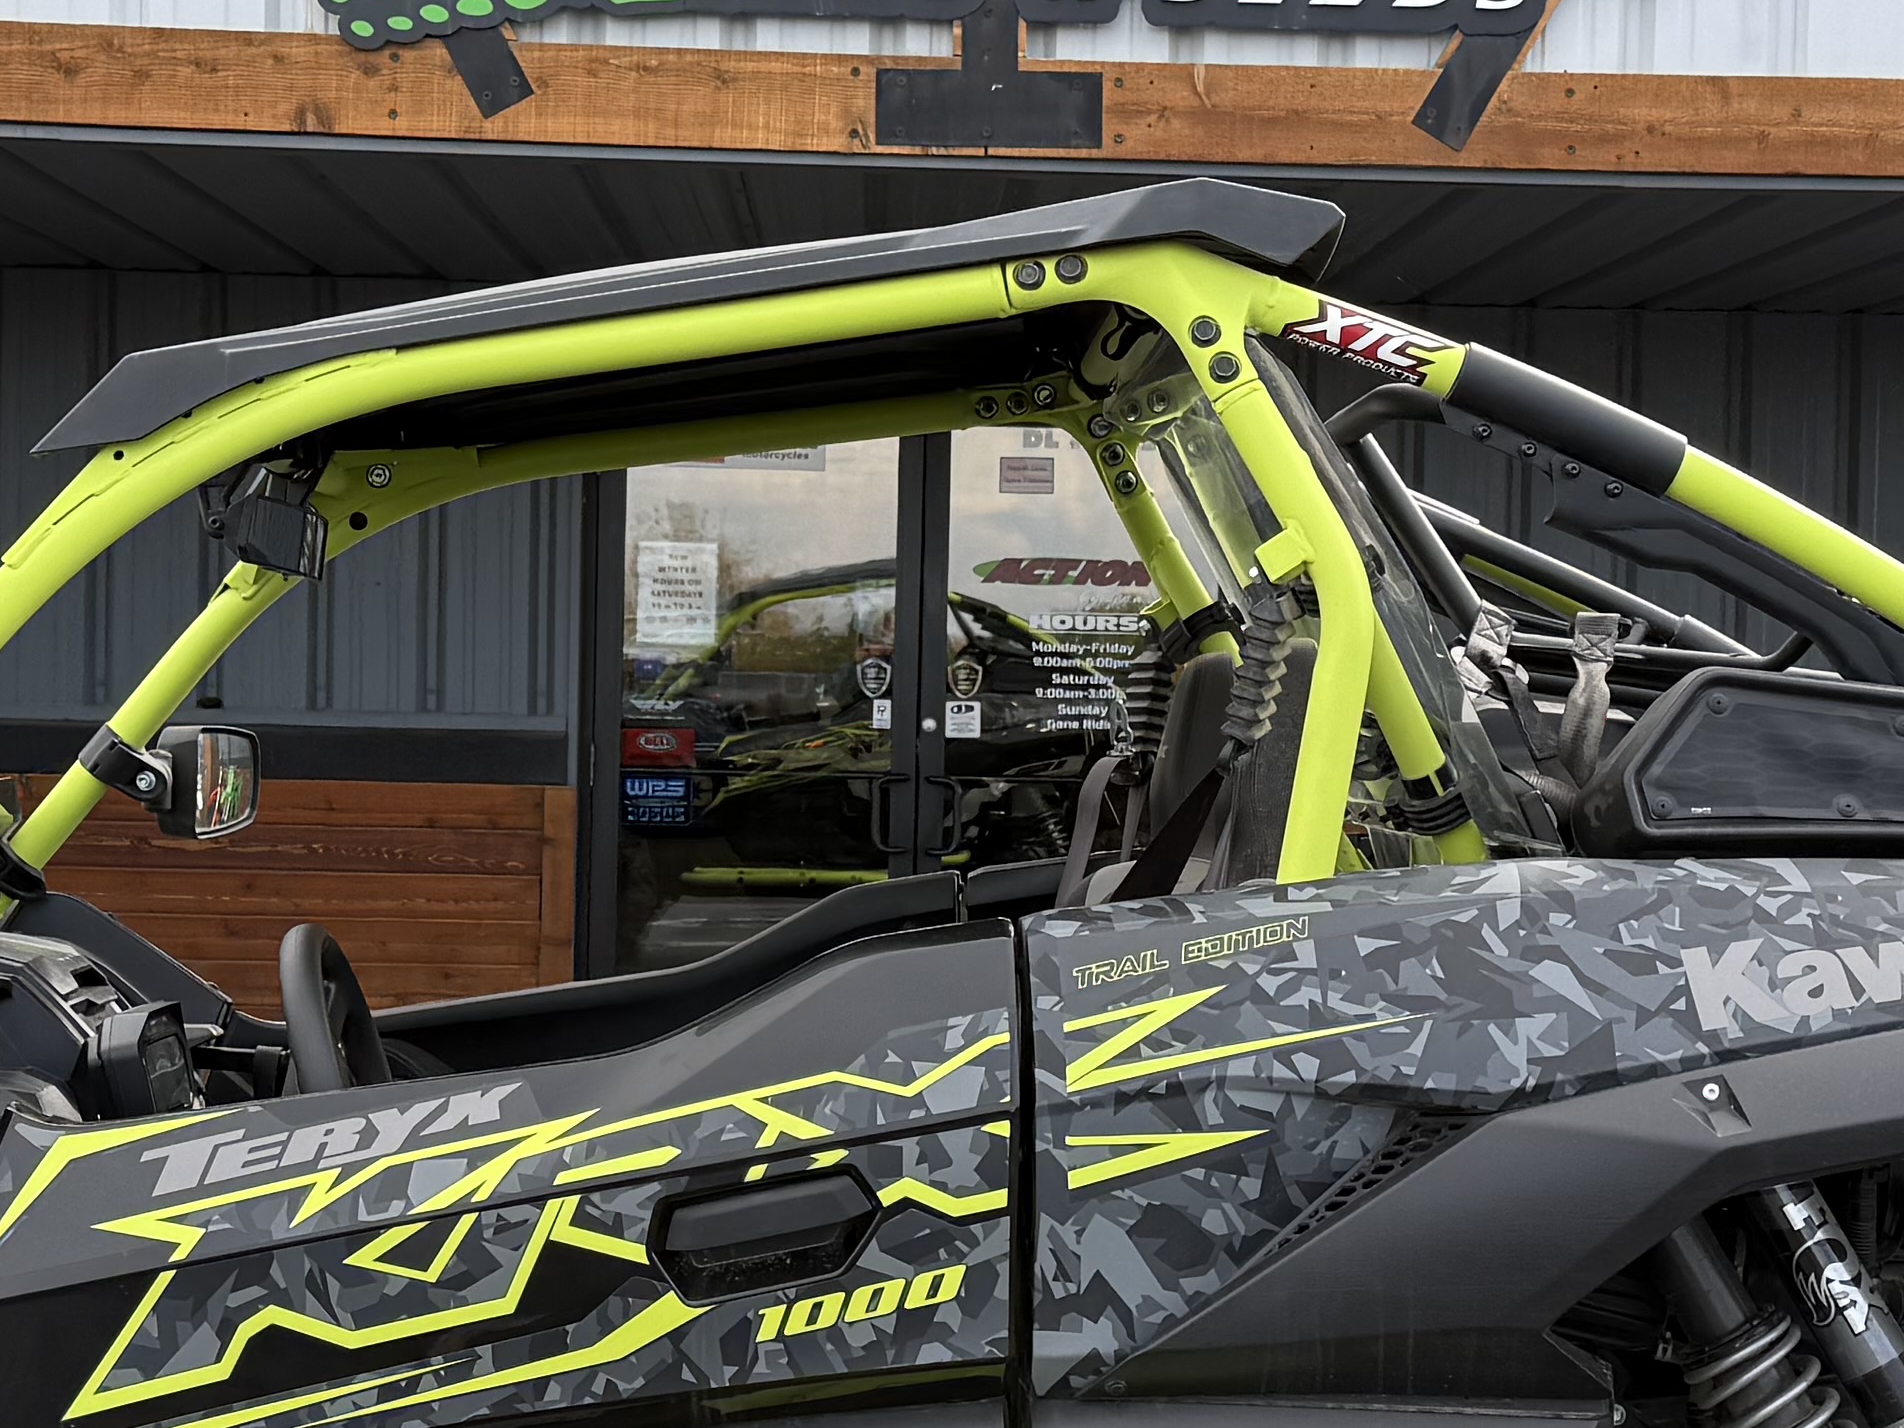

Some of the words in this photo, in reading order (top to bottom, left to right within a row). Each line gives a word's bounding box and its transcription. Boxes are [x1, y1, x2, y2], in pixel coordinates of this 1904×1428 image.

[1293, 304, 1446, 368] XTC
[1286, 333, 1341, 360] POWER
[1342, 352, 1421, 383] PRODUCTS
[981, 557, 1152, 587] ACTION
[1028, 614, 1139, 631] HOURS
[1031, 641, 1136, 655] Monday-Friday
[1051, 672, 1115, 685] Saturday
[1057, 703, 1109, 717] Sunday
[626, 778, 686, 797] WPS
[1073, 949, 1170, 990] TRAIL
[1181, 916, 1309, 965] EDITION
[140, 1083, 523, 1197] TERYX
[757, 1266, 969, 1343] 1000
